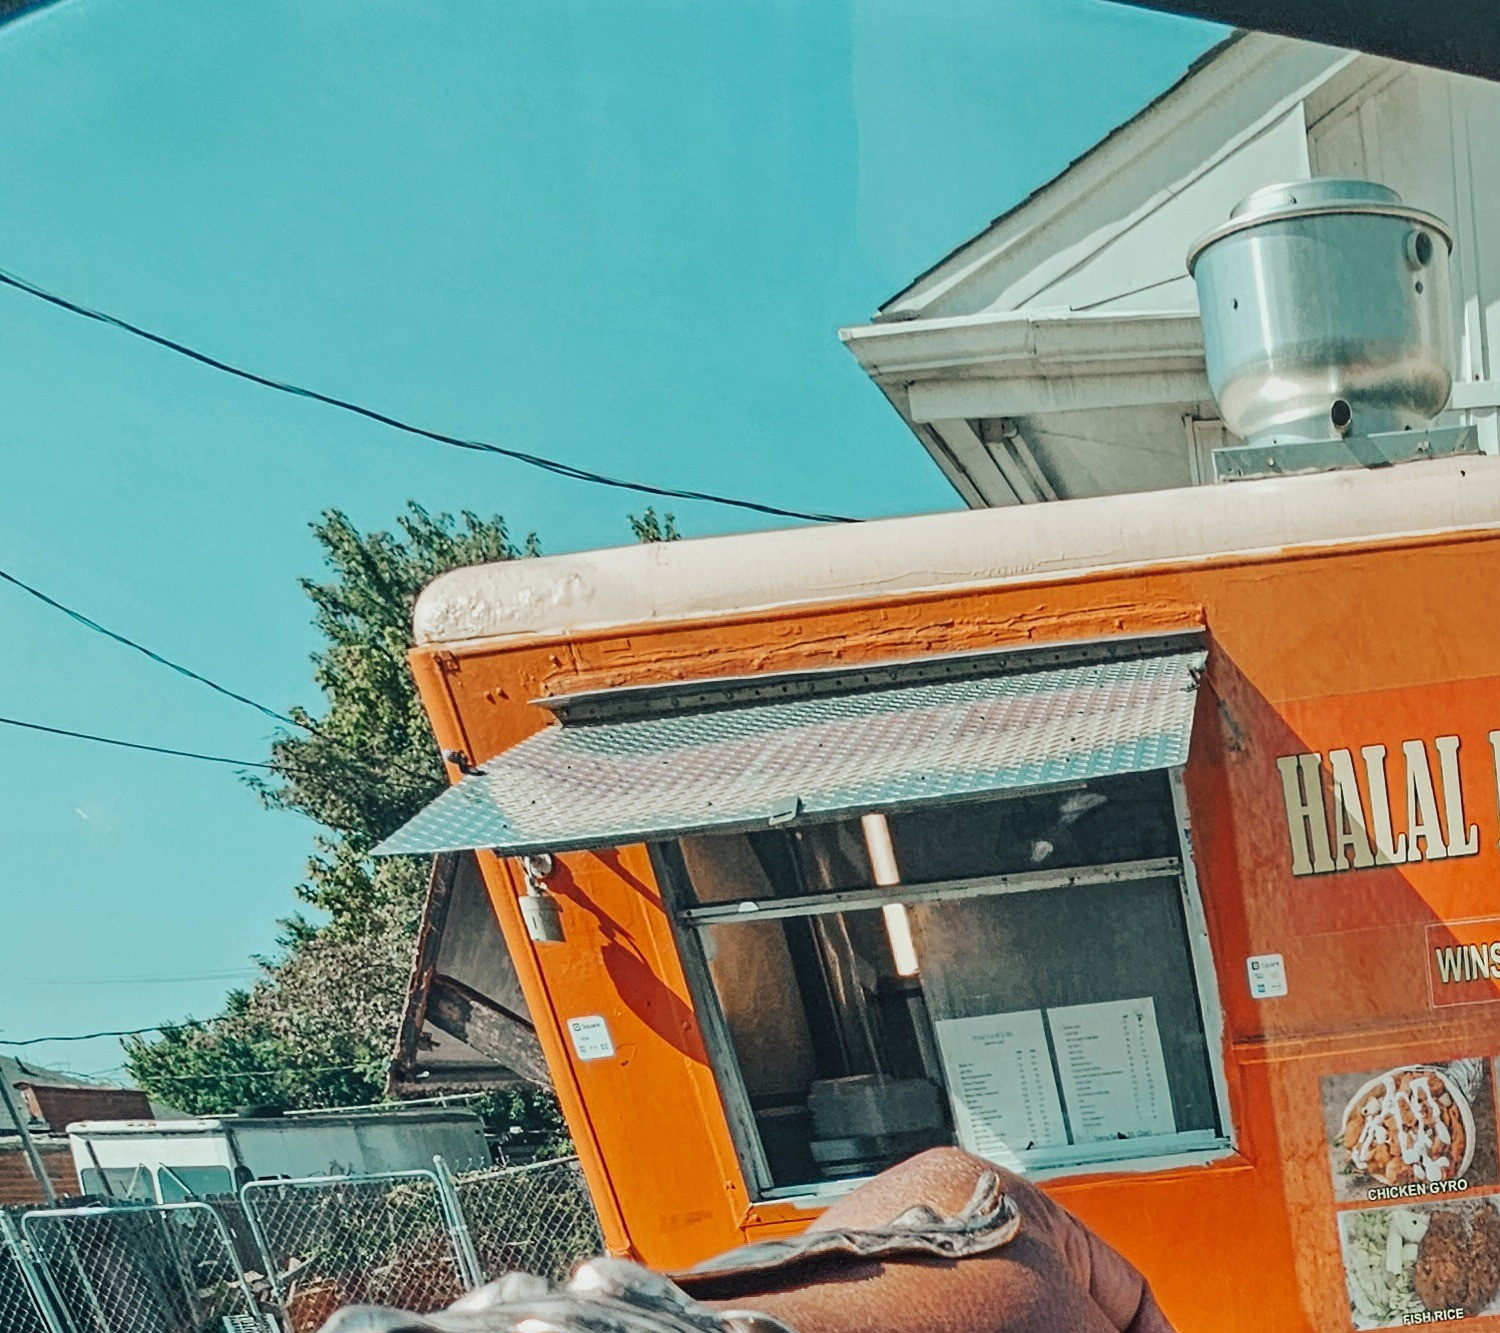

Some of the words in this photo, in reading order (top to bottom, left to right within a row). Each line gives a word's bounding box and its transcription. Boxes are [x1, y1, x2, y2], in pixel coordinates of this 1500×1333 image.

[1277, 736, 1479, 876] HALAL
[1368, 1184, 1426, 1200] CHICKEN
[1429, 1179, 1468, 1194] GYRO
[1403, 1312, 1431, 1325] FISH
[1434, 1308, 1464, 1320] RICE
